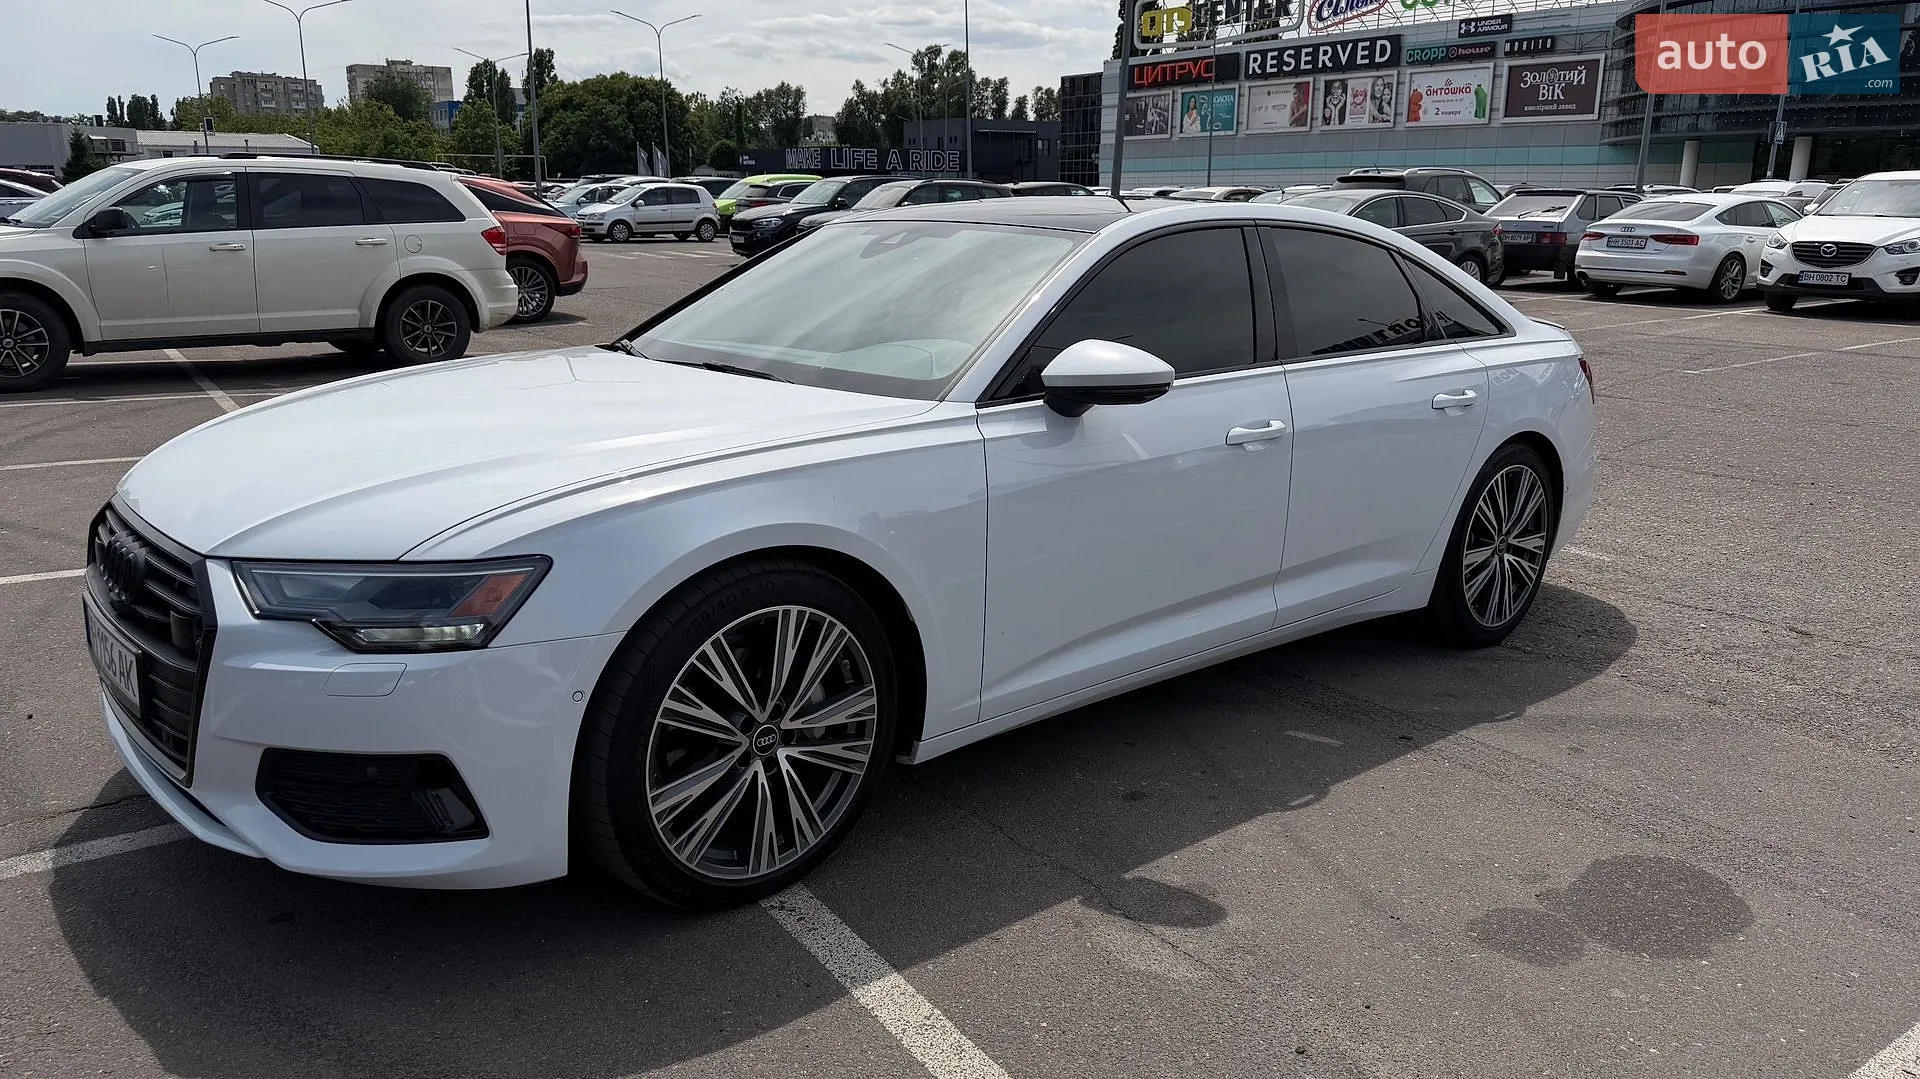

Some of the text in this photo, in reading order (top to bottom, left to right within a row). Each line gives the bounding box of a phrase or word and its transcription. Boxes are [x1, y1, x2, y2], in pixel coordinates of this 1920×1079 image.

[1477, 18, 1501, 27] UNDER
[1477, 24, 1508, 32] ARMOUR
[1458, 46, 1491, 56] house
[1504, 38, 1552, 52] MOHITO
[1248, 39, 1392, 75] RESERVED
[1406, 47, 1446, 62] CROPP
[1134, 58, 1216, 86] ЦИТРУС
[1434, 107, 1440, 116] 2
[785, 148, 960, 171] MAKE LIFE A RIDE
[1835, 274, 1847, 283] TC
